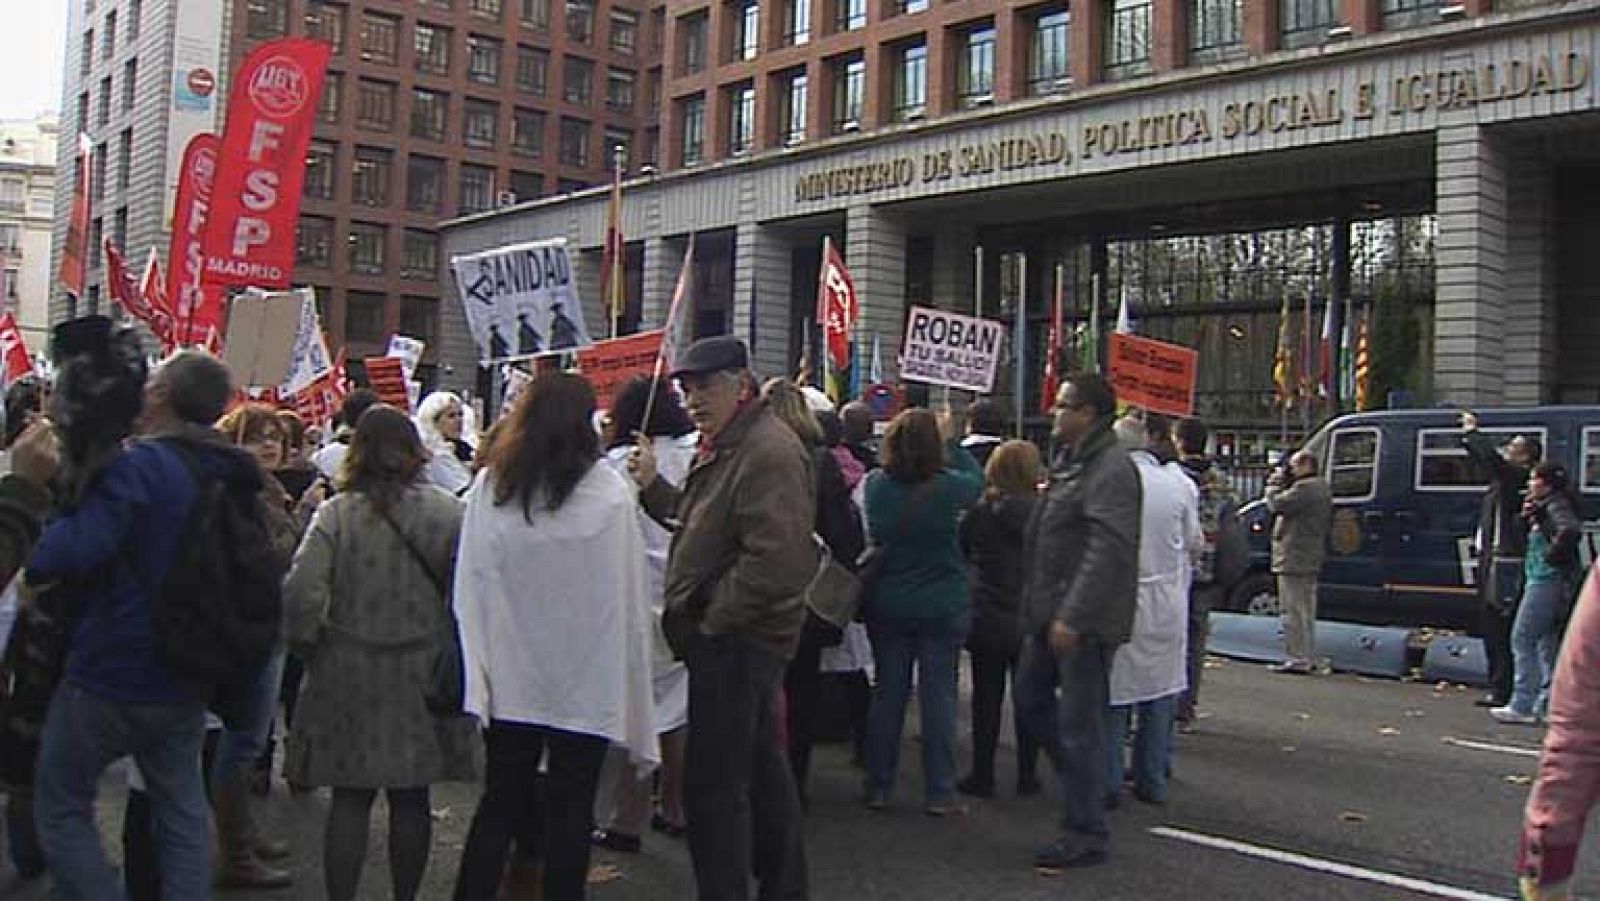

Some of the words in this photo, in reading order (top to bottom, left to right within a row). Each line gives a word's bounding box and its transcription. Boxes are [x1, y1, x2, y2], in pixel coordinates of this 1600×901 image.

[795, 158, 913, 202] MINISTERIO
[922, 149, 952, 184] DE
[959, 131, 1072, 177] SANIDAD,
[1222, 88, 1342, 140] SOCIAL
[1353, 81, 1374, 120] E
[1389, 51, 1588, 117] IGUALDAD
[206, 256, 282, 280] MADRID
[468, 247, 569, 305] SANIDAD
[909, 343, 931, 359] TU
[911, 313, 997, 354] ROBAN
